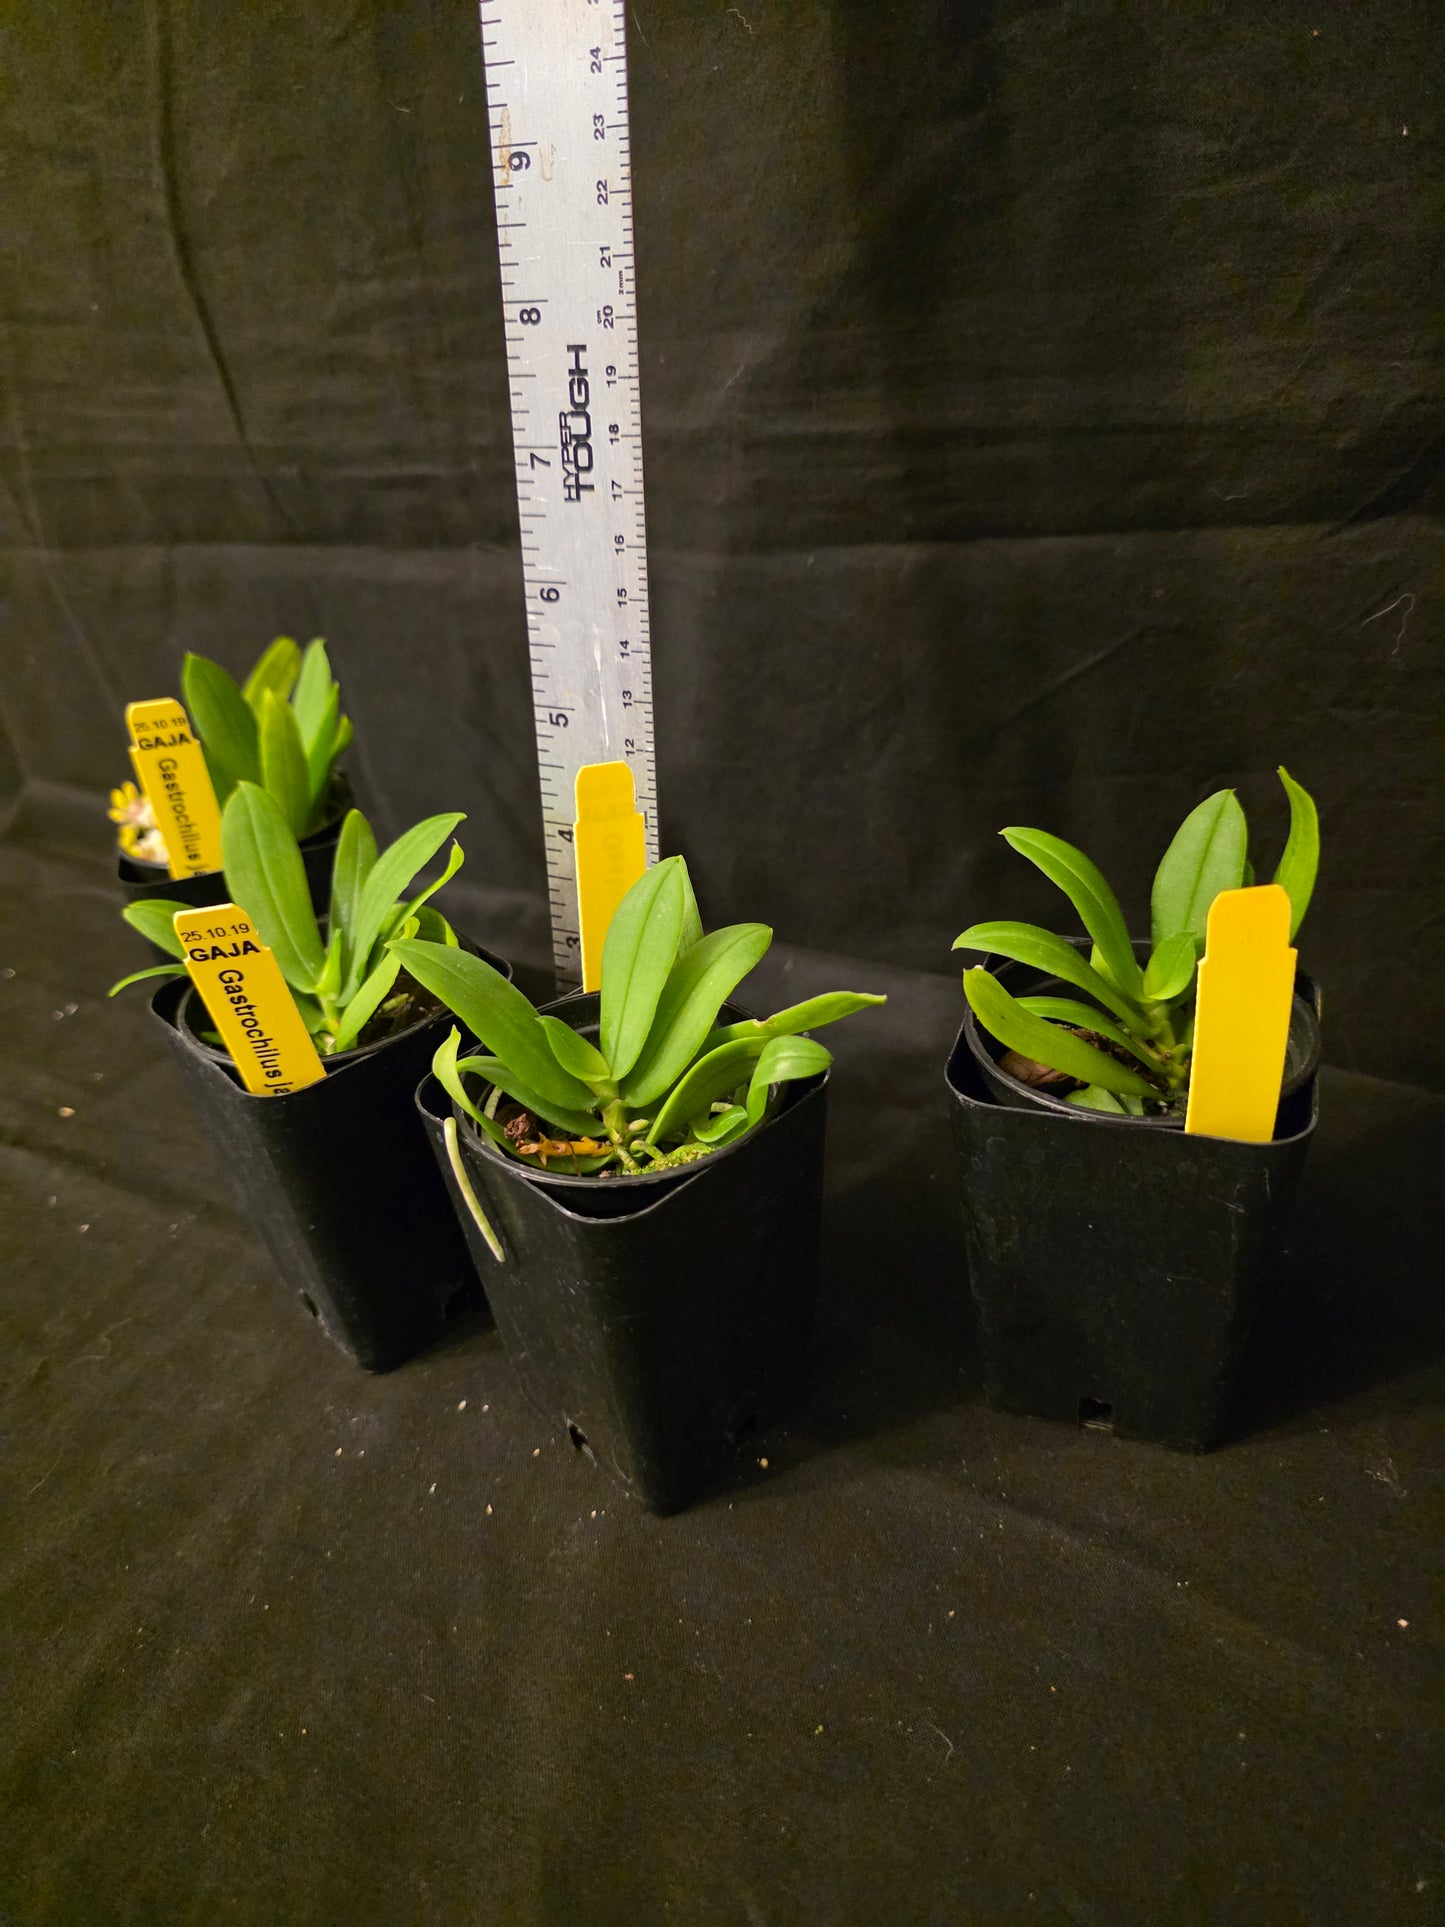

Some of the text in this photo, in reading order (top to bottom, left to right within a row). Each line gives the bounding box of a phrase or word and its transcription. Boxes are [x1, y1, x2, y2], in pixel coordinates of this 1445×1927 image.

[590, 46, 602, 74] 24
[593, 113, 605, 141] 23
[508, 150, 531, 172] 9
[596, 179, 609, 205] 22
[600, 246, 611, 268] 21
[519, 307, 541, 326] 8
[603, 305, 614, 329] 20
[606, 365, 617, 388] 19
[566, 344, 595, 501] TOUGH
[609, 423, 620, 446] 18
[529, 452, 551, 471] 7
[558, 411, 574, 502] HYPER
[612, 480, 623, 501] 17
[614, 534, 625, 556] 16
[540, 587, 560, 603] 6
[617, 588, 628, 608] 15
[619, 639, 630, 659] 14
[623, 690, 633, 708] 13
[550, 712, 569, 728] 5
[138, 733, 192, 751] GAJA
[624, 738, 635, 757] 12
[158, 757, 201, 861] Gastrochilus
[557, 829, 574, 843] 4
[180, 922, 250, 943] 25.10.19
[566, 936, 581, 949] 3
[189, 939, 261, 962] GAJA
[218, 969, 283, 1079] Gastrochilus
